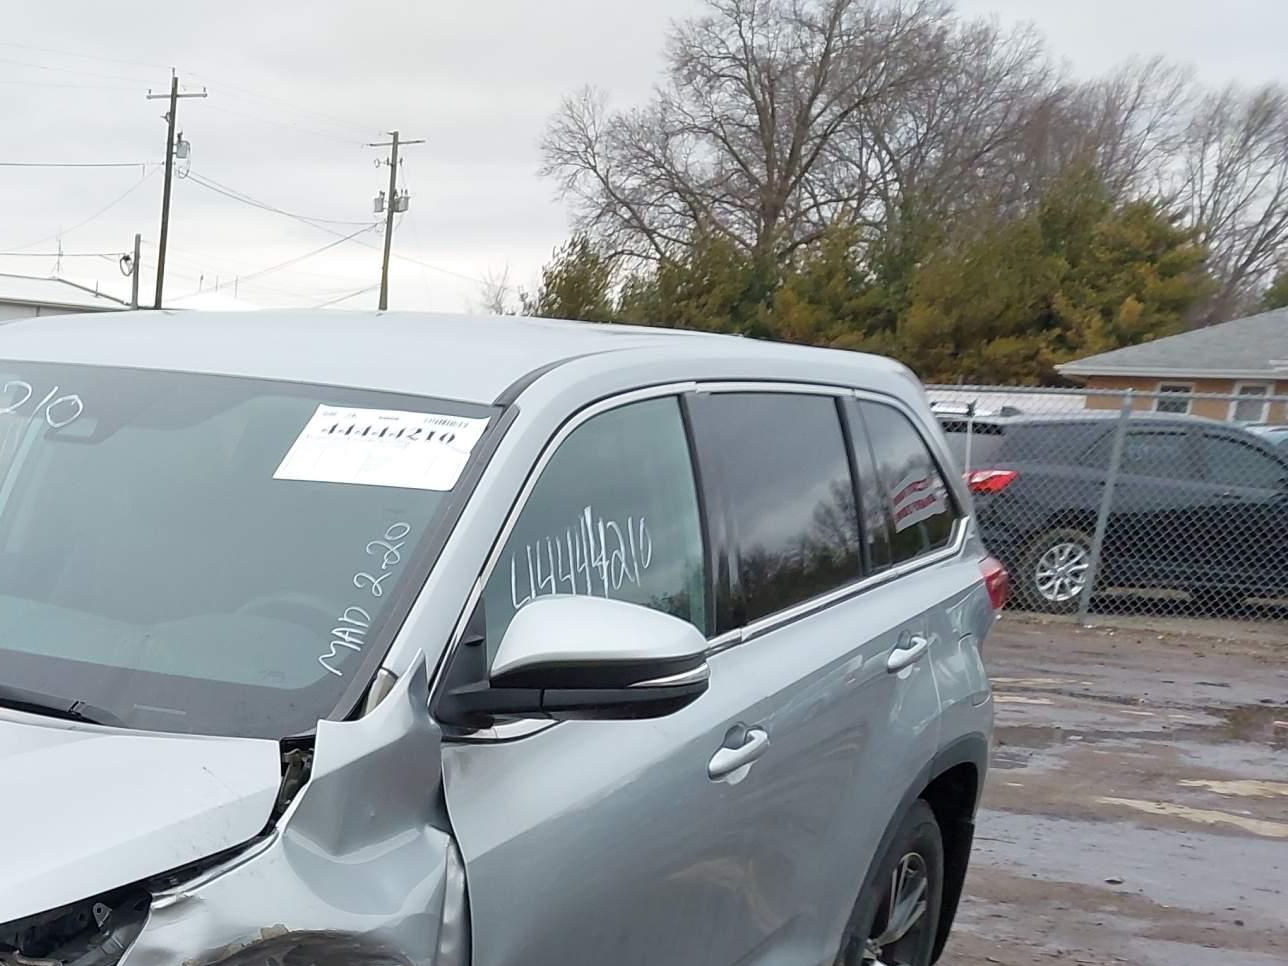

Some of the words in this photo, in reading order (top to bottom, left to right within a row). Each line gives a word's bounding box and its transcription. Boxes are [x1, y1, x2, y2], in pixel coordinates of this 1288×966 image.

[321, 422, 456, 445] 44444210
[318, 606, 371, 676] MAD
[353, 521, 411, 597] 2-20
